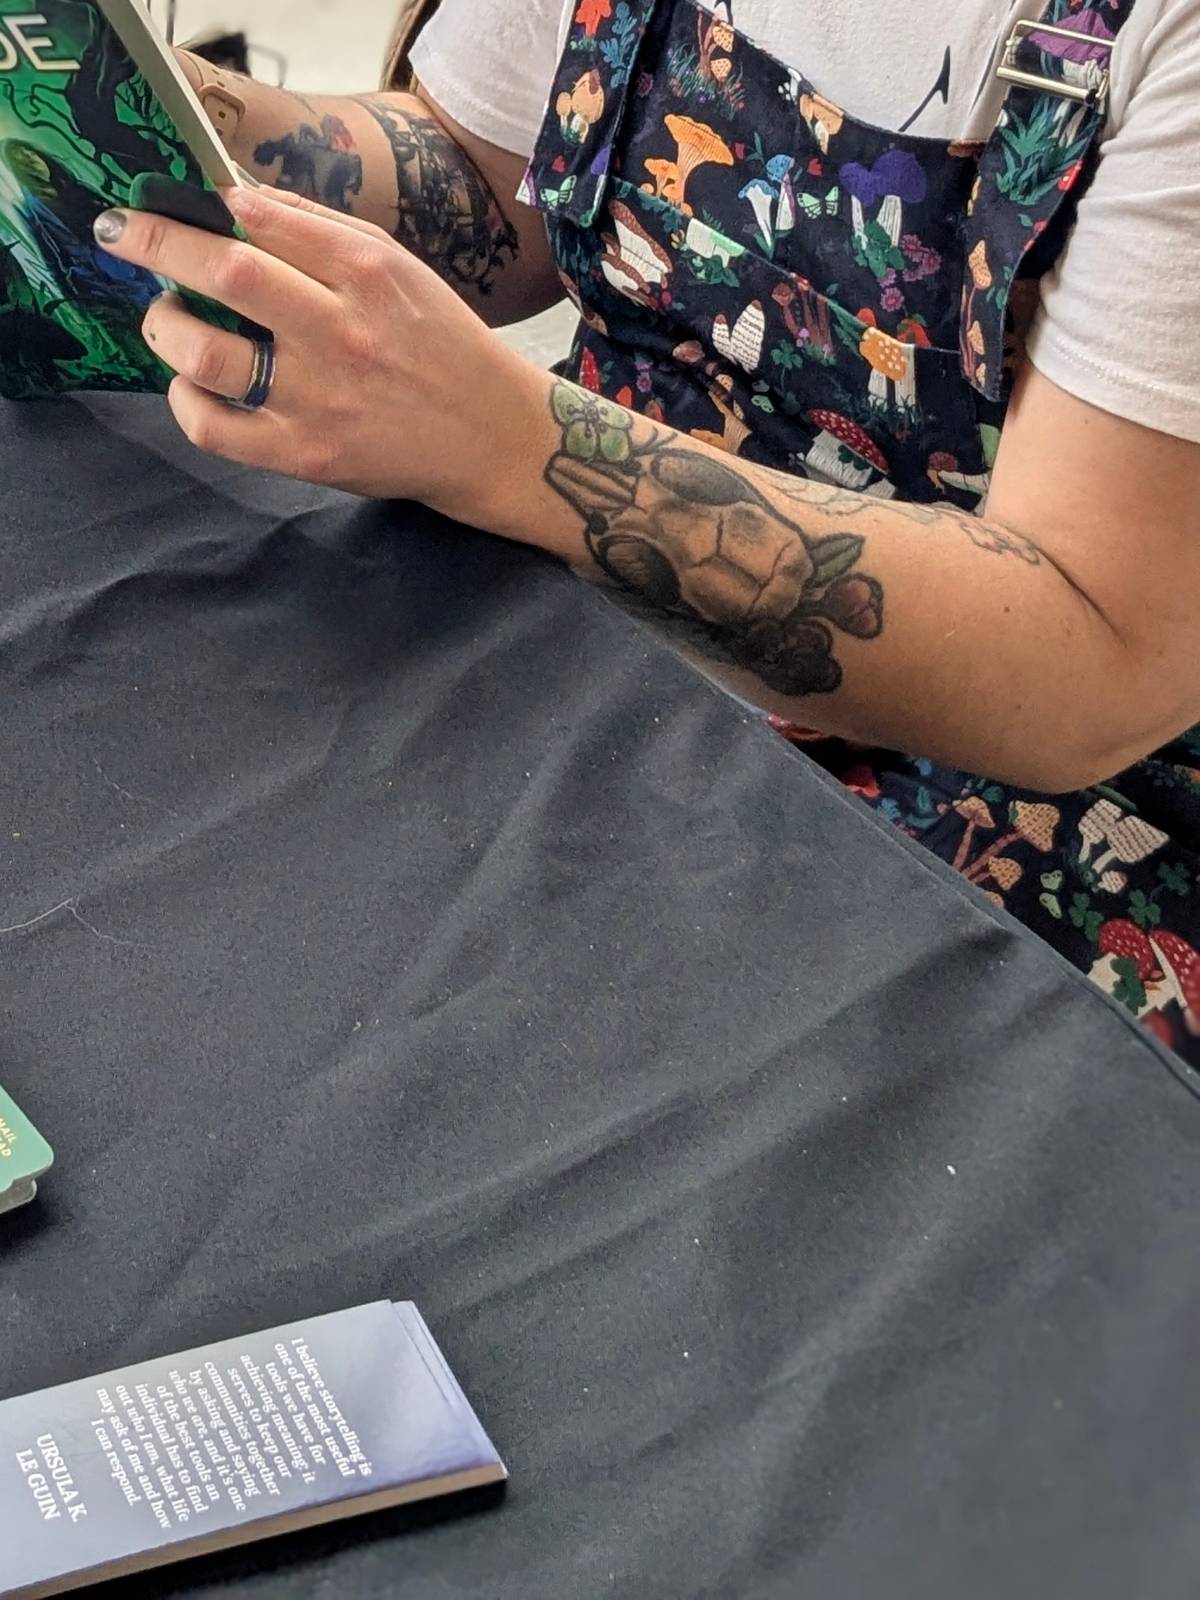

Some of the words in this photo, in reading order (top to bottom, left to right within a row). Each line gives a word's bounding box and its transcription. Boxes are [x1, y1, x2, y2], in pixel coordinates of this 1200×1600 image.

[275, 1344, 292, 1365] one
[291, 1337, 304, 1345] I
[287, 1367, 305, 1380] of
[296, 1344, 324, 1388] believe
[156, 1385, 174, 1398] of
[295, 1380, 312, 1402] the
[164, 1399, 181, 1421] the
[227, 1368, 254, 1407] serves
[249, 1408, 262, 1422] to
[256, 1422, 279, 1454] keep
[273, 1455, 292, 1478] our
[240, 1355, 279, 1413] achieving
[271, 1413, 309, 1471] meaning:
[302, 1471, 316, 1484] it
[265, 1362, 288, 1393] tools
[282, 1393, 298, 1413] we
[292, 1412, 314, 1444] have
[308, 1444, 326, 1464] for
[307, 1403, 331, 1436] most
[319, 1389, 367, 1463] storytelling
[168, 1370, 187, 1395] who
[182, 1396, 197, 1414] we
[191, 1415, 208, 1439] are,
[203, 1439, 226, 1464] and
[216, 1465, 234, 1486] it's
[227, 1486, 246, 1511] one
[174, 1420, 196, 1450] best
[188, 1369, 203, 1385] by
[198, 1388, 226, 1430] asking
[218, 1429, 242, 1453] and
[232, 1454, 261, 1497] saying
[204, 1362, 252, 1440] communities
[246, 1440, 280, 1495] together
[16, 1448, 39, 1473] LE
[189, 1450, 212, 1482] tools
[324, 1436, 356, 1477] useful
[358, 1462, 372, 1476] is
[37, 1433, 79, 1504] URSULA
[67, 1503, 87, 1522] K.
[205, 1483, 220, 1501] an
[27, 1473, 61, 1520] GUIN
